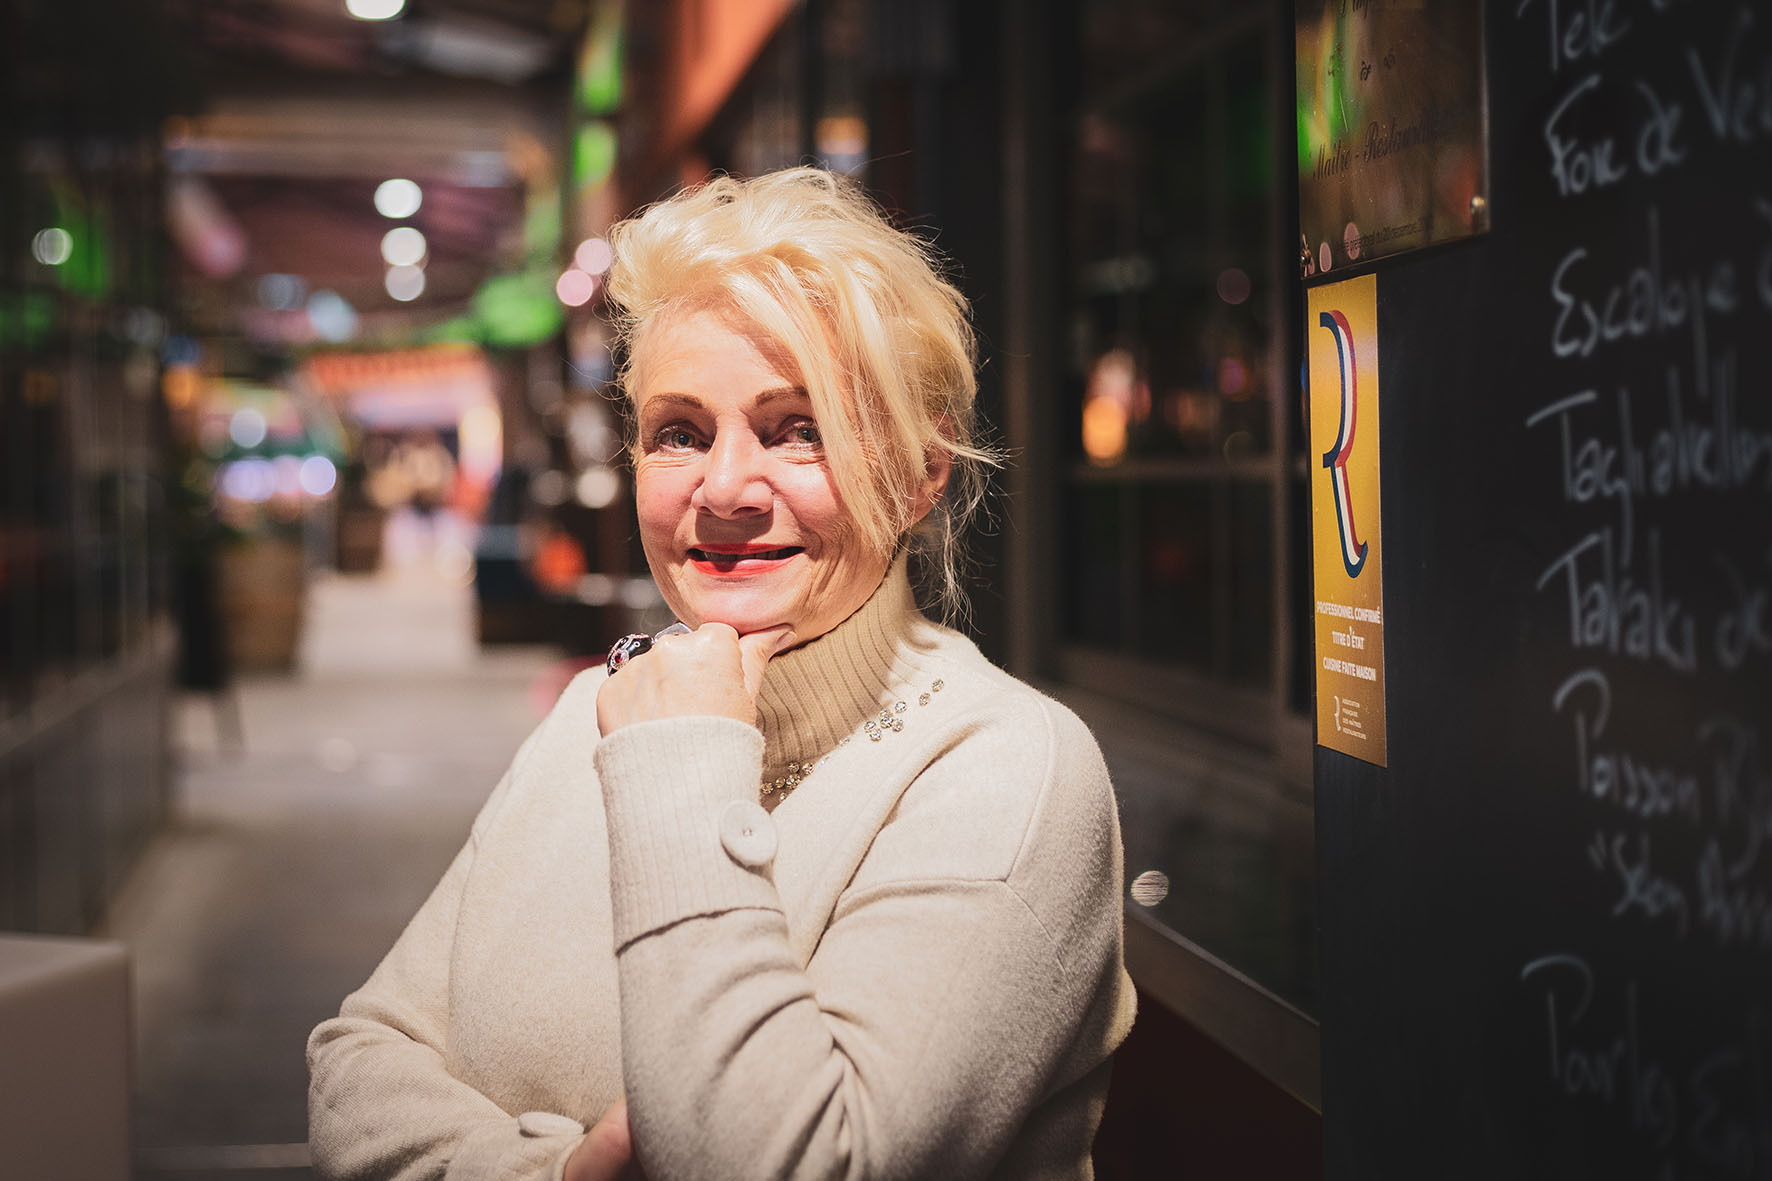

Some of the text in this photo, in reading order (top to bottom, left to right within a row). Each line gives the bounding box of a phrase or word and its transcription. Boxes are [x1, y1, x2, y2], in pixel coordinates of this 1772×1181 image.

[1317, 601, 1381, 625] PROFESSIONNEL CONFIRMÉ
[1332, 631, 1346, 647] TITRE
[1323, 656, 1377, 682] CUISINE FAITE MAISON
